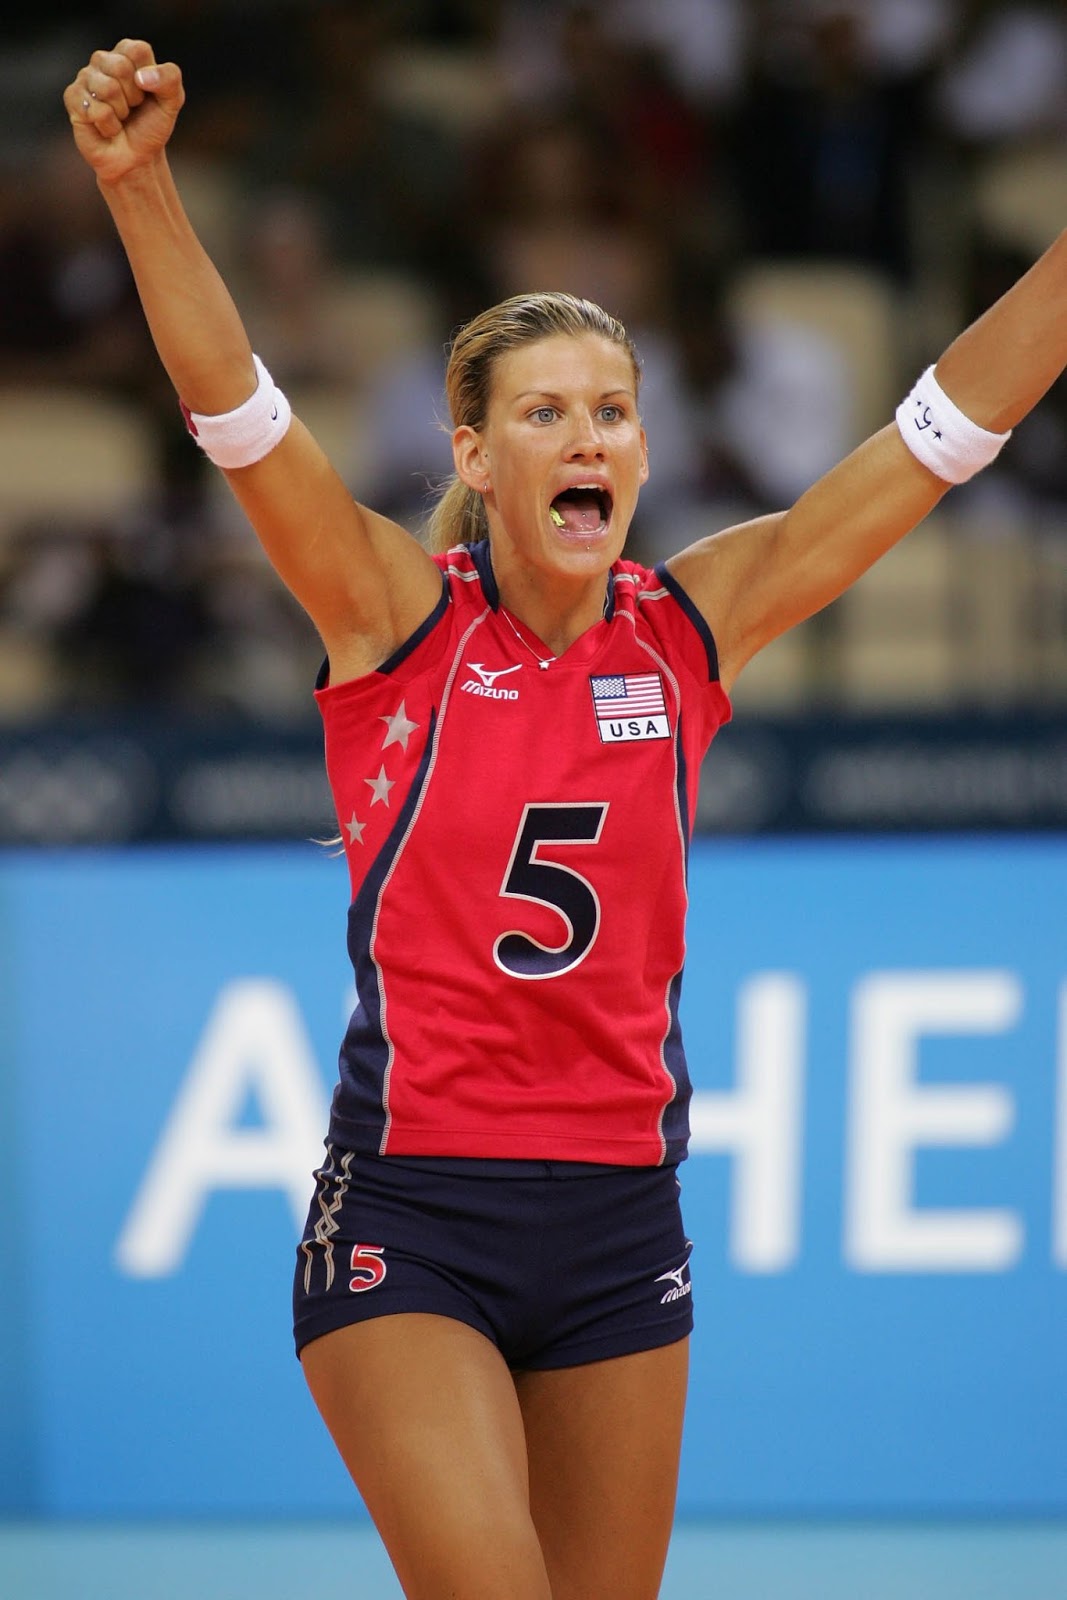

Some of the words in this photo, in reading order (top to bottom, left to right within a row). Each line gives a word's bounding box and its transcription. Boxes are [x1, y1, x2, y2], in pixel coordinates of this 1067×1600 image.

[609, 720, 659, 738] USA
[493, 802, 611, 980] 5
[112, 967, 1067, 1277] AHE
[349, 1244, 387, 1293] 5
